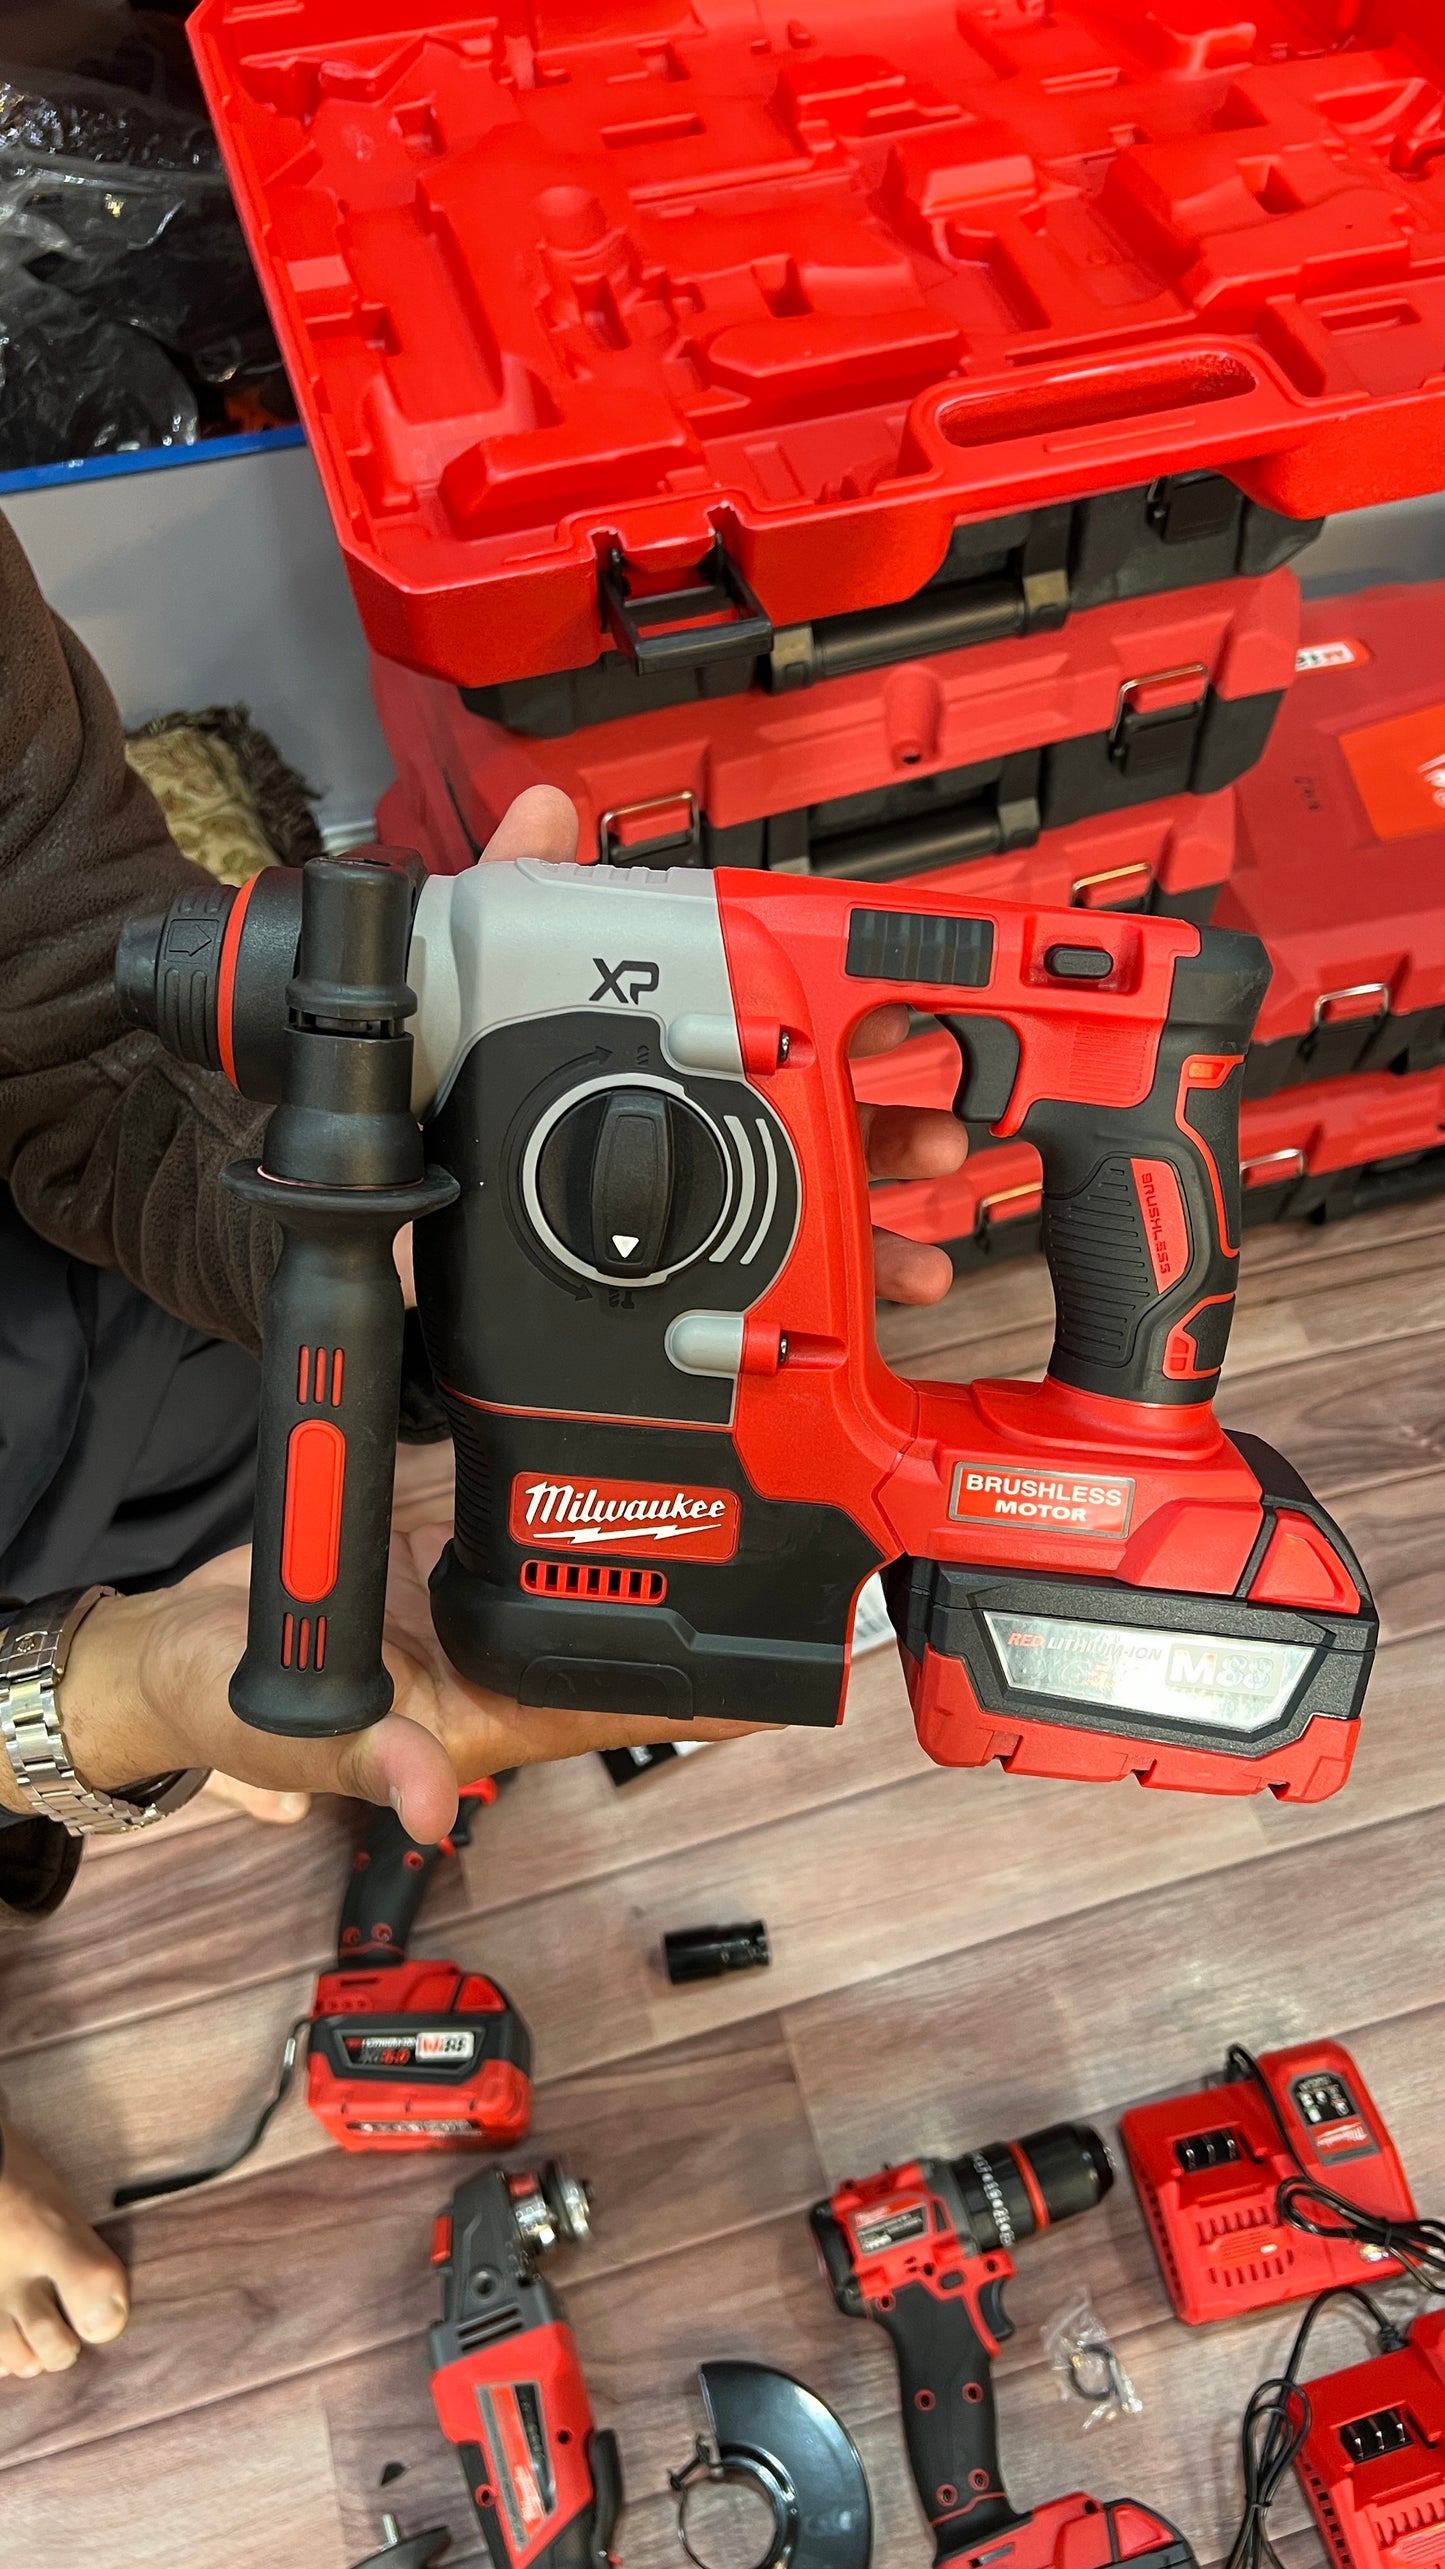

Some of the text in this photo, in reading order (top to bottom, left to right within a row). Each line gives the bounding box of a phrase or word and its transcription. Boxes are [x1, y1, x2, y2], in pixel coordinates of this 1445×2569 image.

[588, 957, 660, 1006] XP
[1141, 1172, 1171, 1274] BRUSHLESS
[525, 1481, 727, 1527] Milwaukee
[966, 1473, 1123, 1507] BRUSHLESS
[994, 1499, 1087, 1522] MOTOR
[1007, 1632, 1163, 1661] RED LITHIUM-ION
[1169, 1650, 1276, 1691] M88
